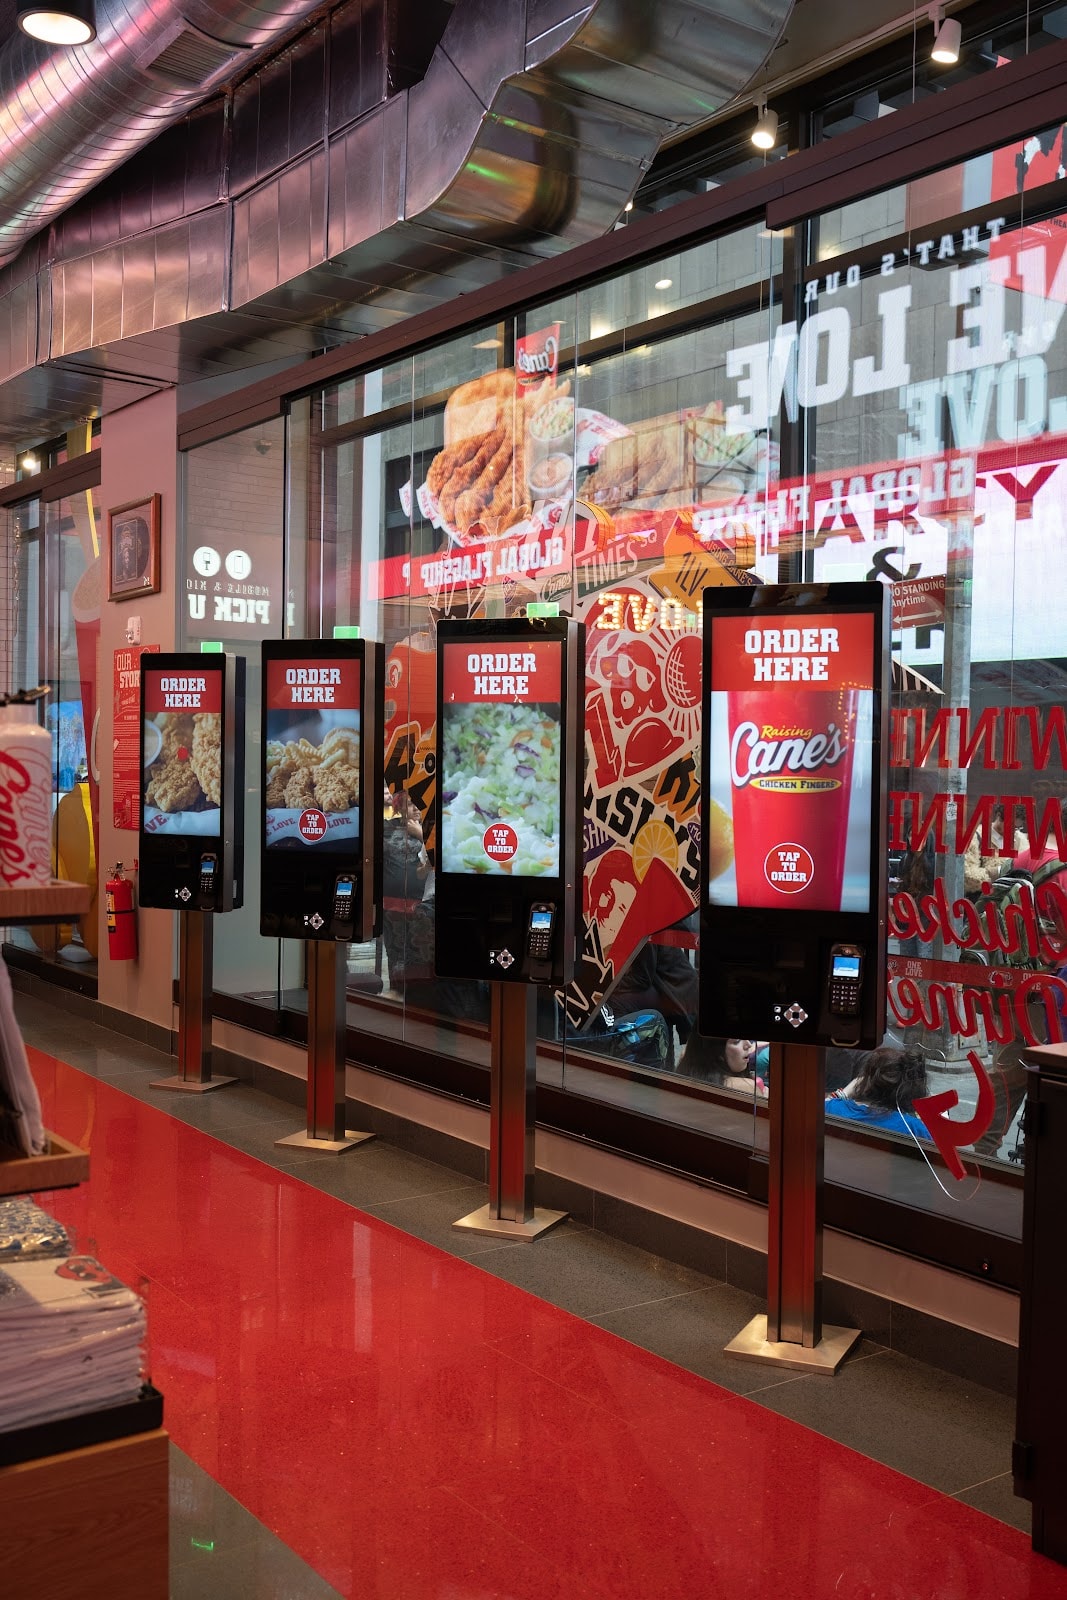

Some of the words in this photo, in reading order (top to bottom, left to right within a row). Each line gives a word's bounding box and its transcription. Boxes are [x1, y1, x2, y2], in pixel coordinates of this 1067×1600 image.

[581, 540, 639, 592] TIMES
[903, 580, 945, 595] STANDING
[892, 596, 926, 608] Anytime
[745, 628, 840, 654] ORDER
[116, 653, 132, 671] OUR
[467, 653, 537, 673] ORDER
[753, 657, 829, 682] HERE
[119, 670, 141, 689] STOR
[161, 677, 206, 692] ORDER
[286, 668, 341, 686] ORDER
[474, 675, 529, 696] HERE
[165, 694, 201, 708] HERE
[291, 687, 335, 703] HERE
[761, 725, 814, 740] Raising
[731, 721, 848, 787] Cane's
[759, 780, 797, 789] CHICKEN
[800, 780, 838, 789] FINGERS
[272, 818, 295, 831] LOVE
[327, 817, 351, 828] LOVE
[492, 829, 509, 838] TAP
[495, 837, 506, 846] TO
[487, 845, 514, 855] ORDER
[777, 851, 800, 862] TAP
[781, 861, 797, 872] TO
[771, 871, 807, 883] ORDER
[905, 967, 923, 978] LOVE
[907, 960, 921, 970] ONE
